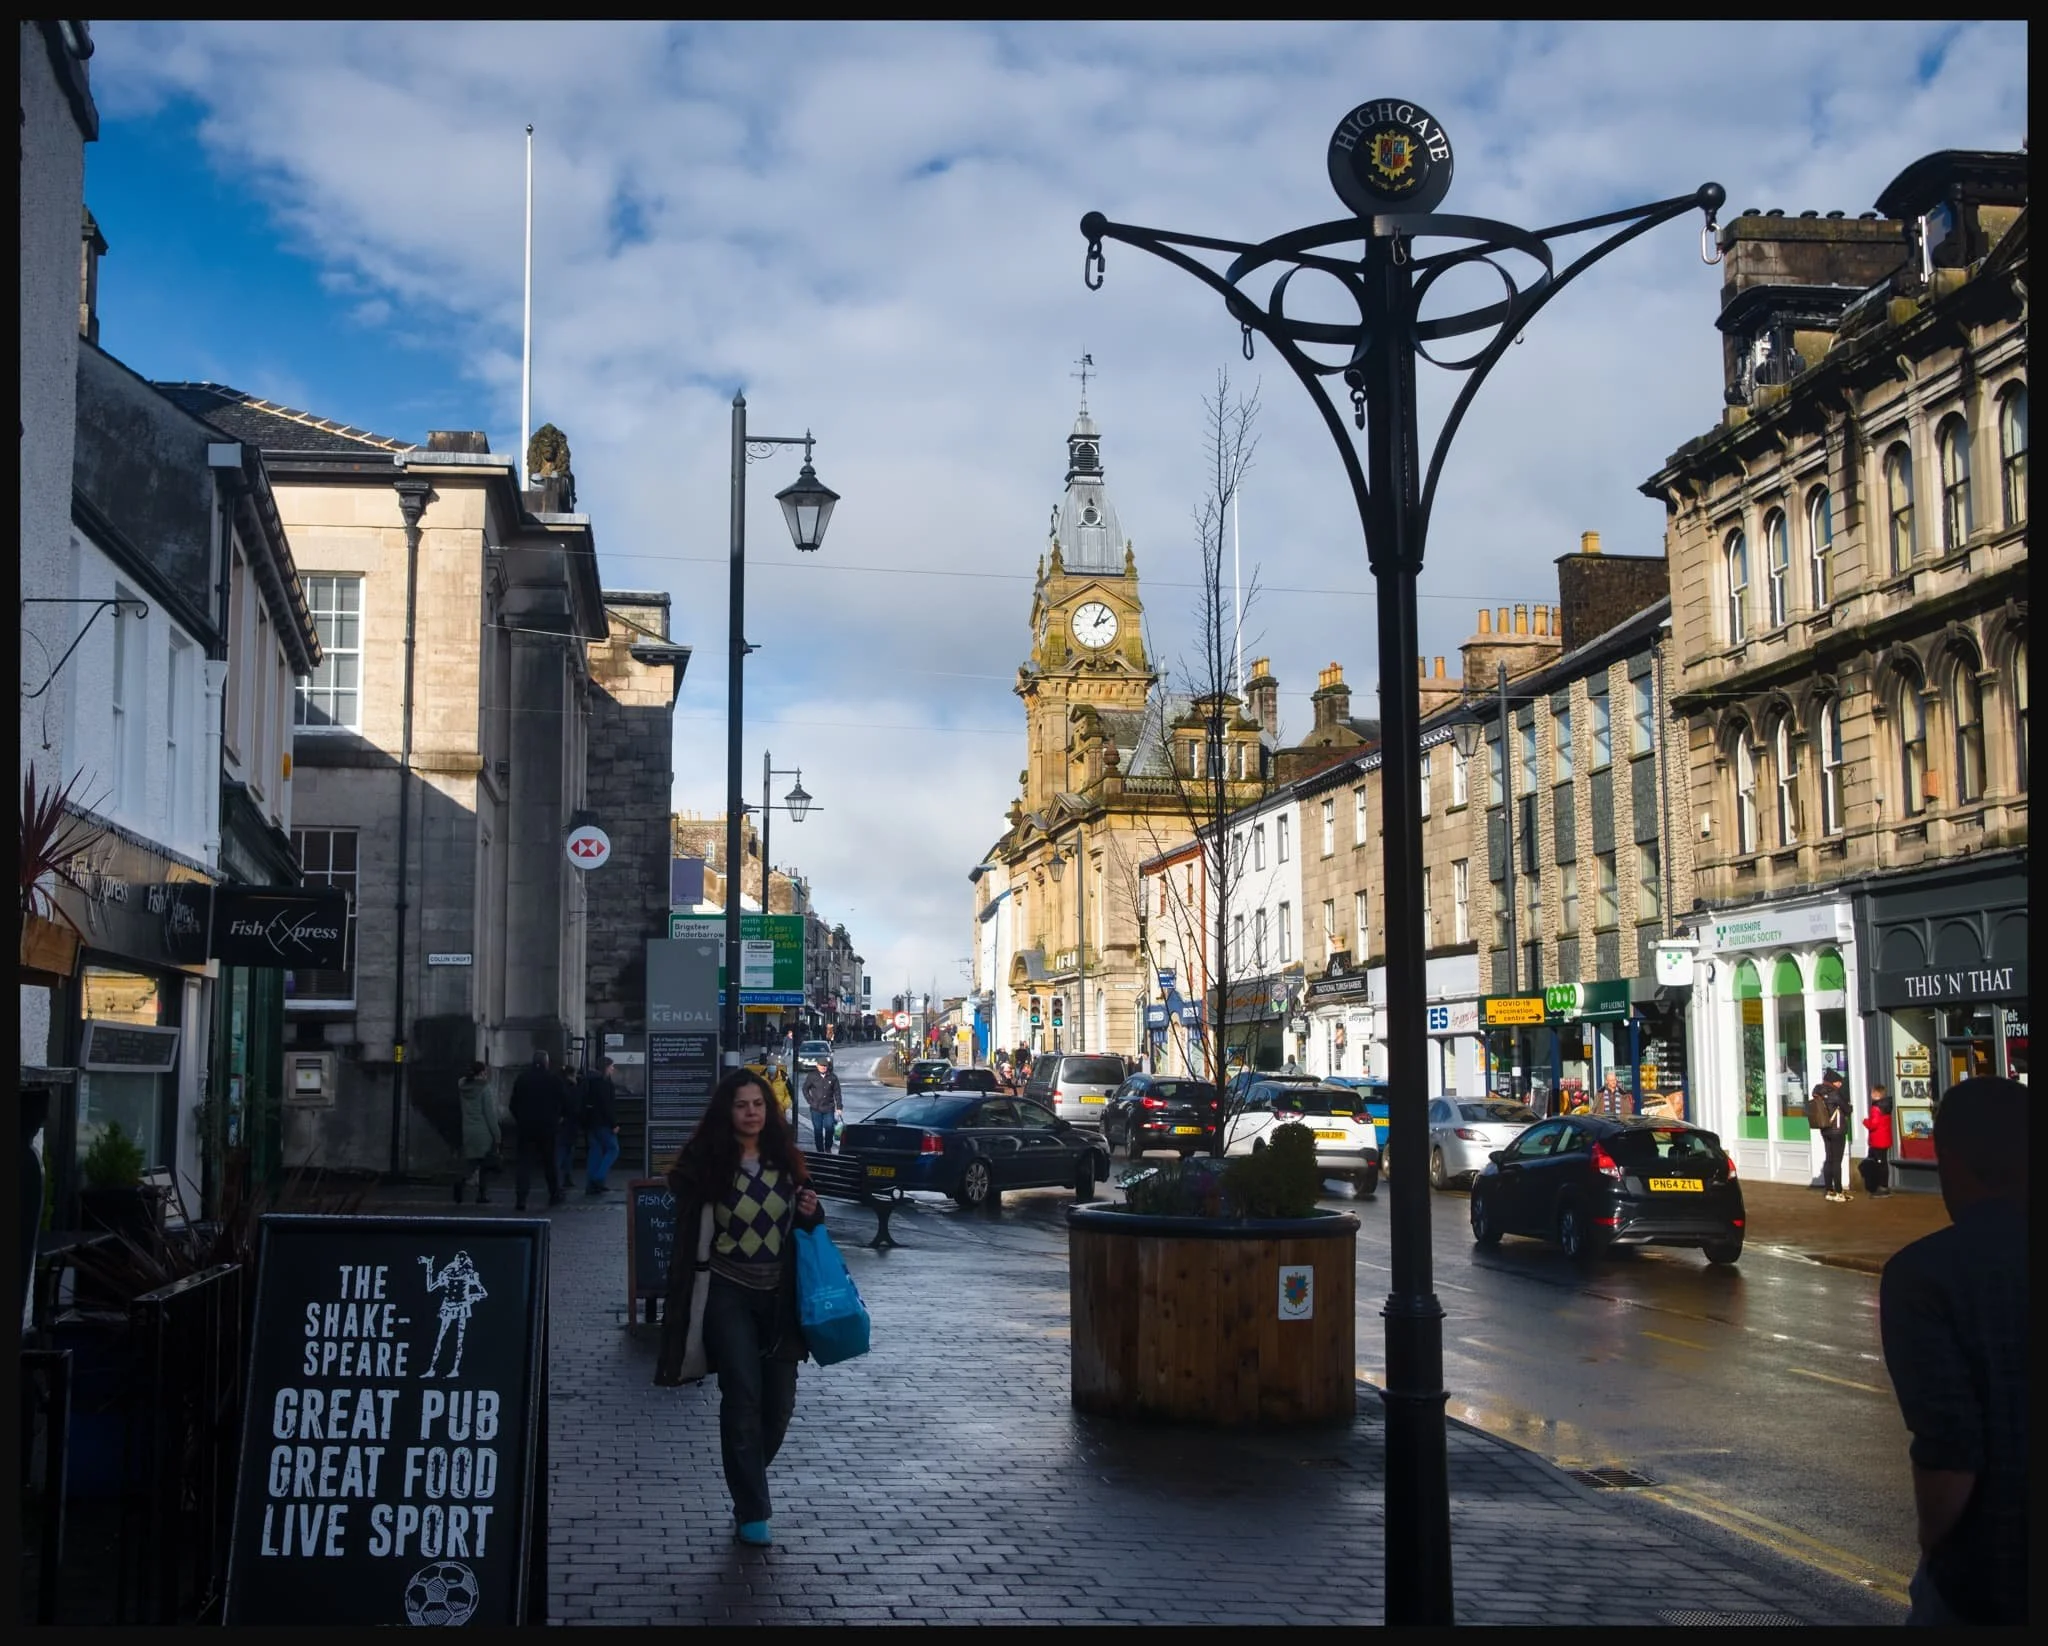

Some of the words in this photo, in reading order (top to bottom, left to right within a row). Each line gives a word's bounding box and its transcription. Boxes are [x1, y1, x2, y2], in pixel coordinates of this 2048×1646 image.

[1335, 103, 1449, 162] HIGHGATE
[148, 885, 164, 914] Fish
[230, 920, 264, 936] Fish
[674, 923, 710, 931] Brigsteer
[1728, 921, 1761, 935] YORKSHIRE
[1729, 934, 1756, 946] BUILDING
[1757, 930, 1782, 943] SOCIETY
[1905, 974, 1941, 998] THIS
[1945, 972, 1964, 995] 'N'
[1968, 968, 2013, 992] THAT
[1549, 989, 1575, 1006] FOOD
[652, 1010, 712, 1022] KENDAL
[1427, 1007, 1448, 1030] ES
[2002, 1009, 2018, 1022] Tel:
[1653, 1179, 1678, 1189] PN64
[1681, 1180, 1699, 1190] ZTL
[339, 1265, 389, 1300] THE
[304, 1302, 411, 1338] SHAKE-
[303, 1341, 410, 1377] SPEARE
[272, 1387, 400, 1440] GREAT
[420, 1389, 500, 1441] PUB
[268, 1445, 385, 1498] GREAT
[403, 1446, 498, 1499] FOOD
[260, 1503, 349, 1557] LIVE
[368, 1504, 494, 1558] SPORT
